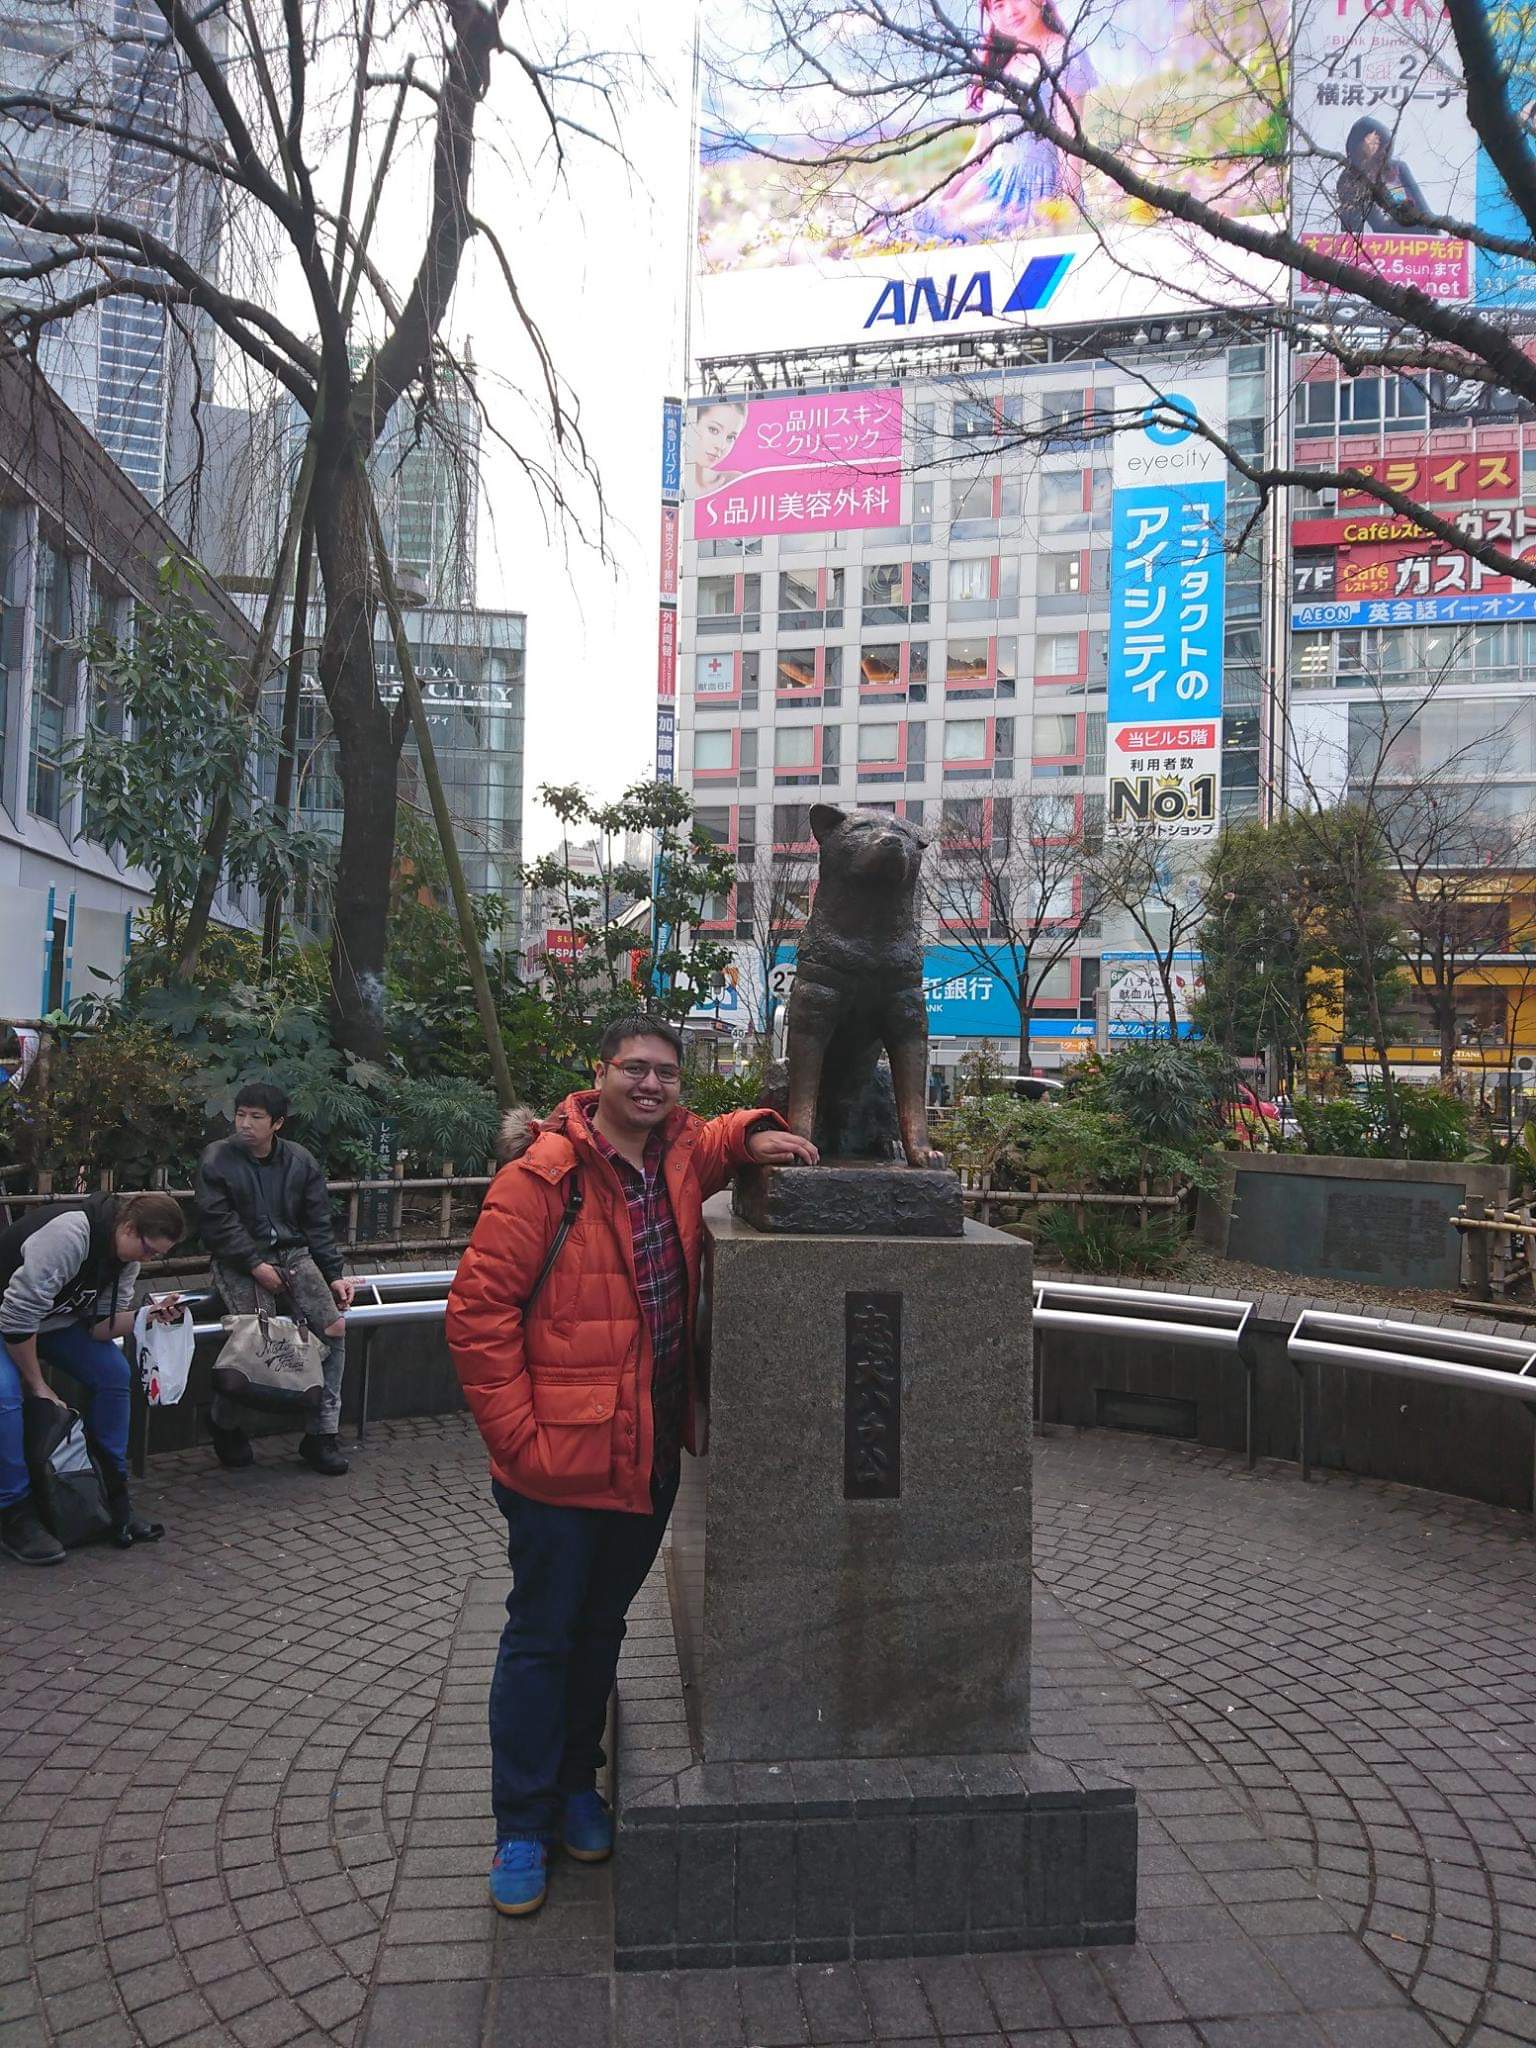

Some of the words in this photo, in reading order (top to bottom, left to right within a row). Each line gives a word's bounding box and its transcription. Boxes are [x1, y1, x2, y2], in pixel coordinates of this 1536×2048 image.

[1316, 83, 1459, 108] 横浜アリーナ
[863, 270, 993, 328] ANA
[786, 404, 892, 432] 品川スキン
[786, 428, 880, 456] クリニック
[1128, 449, 1212, 475] eyecity
[723, 485, 890, 526] 品川美容外科
[1294, 566, 1335, 590] 7F
[1343, 562, 1389, 581] Café
[1395, 556, 1502, 595] ガスト
[1345, 581, 1388, 592] レストラン
[1123, 506, 1170, 703] アイシティ
[1176, 503, 1210, 700] コンタクトの
[1301, 606, 1351, 624] AEON
[1368, 598, 1526, 623] 英会話イーオン
[428, 682, 514, 701] CITY
[1128, 727, 1208, 748] 当ビル5階
[1130, 756, 1195, 772] 利用者数
[1110, 773, 1216, 822] No.1
[1108, 823, 1214, 838] コンタクトショップ
